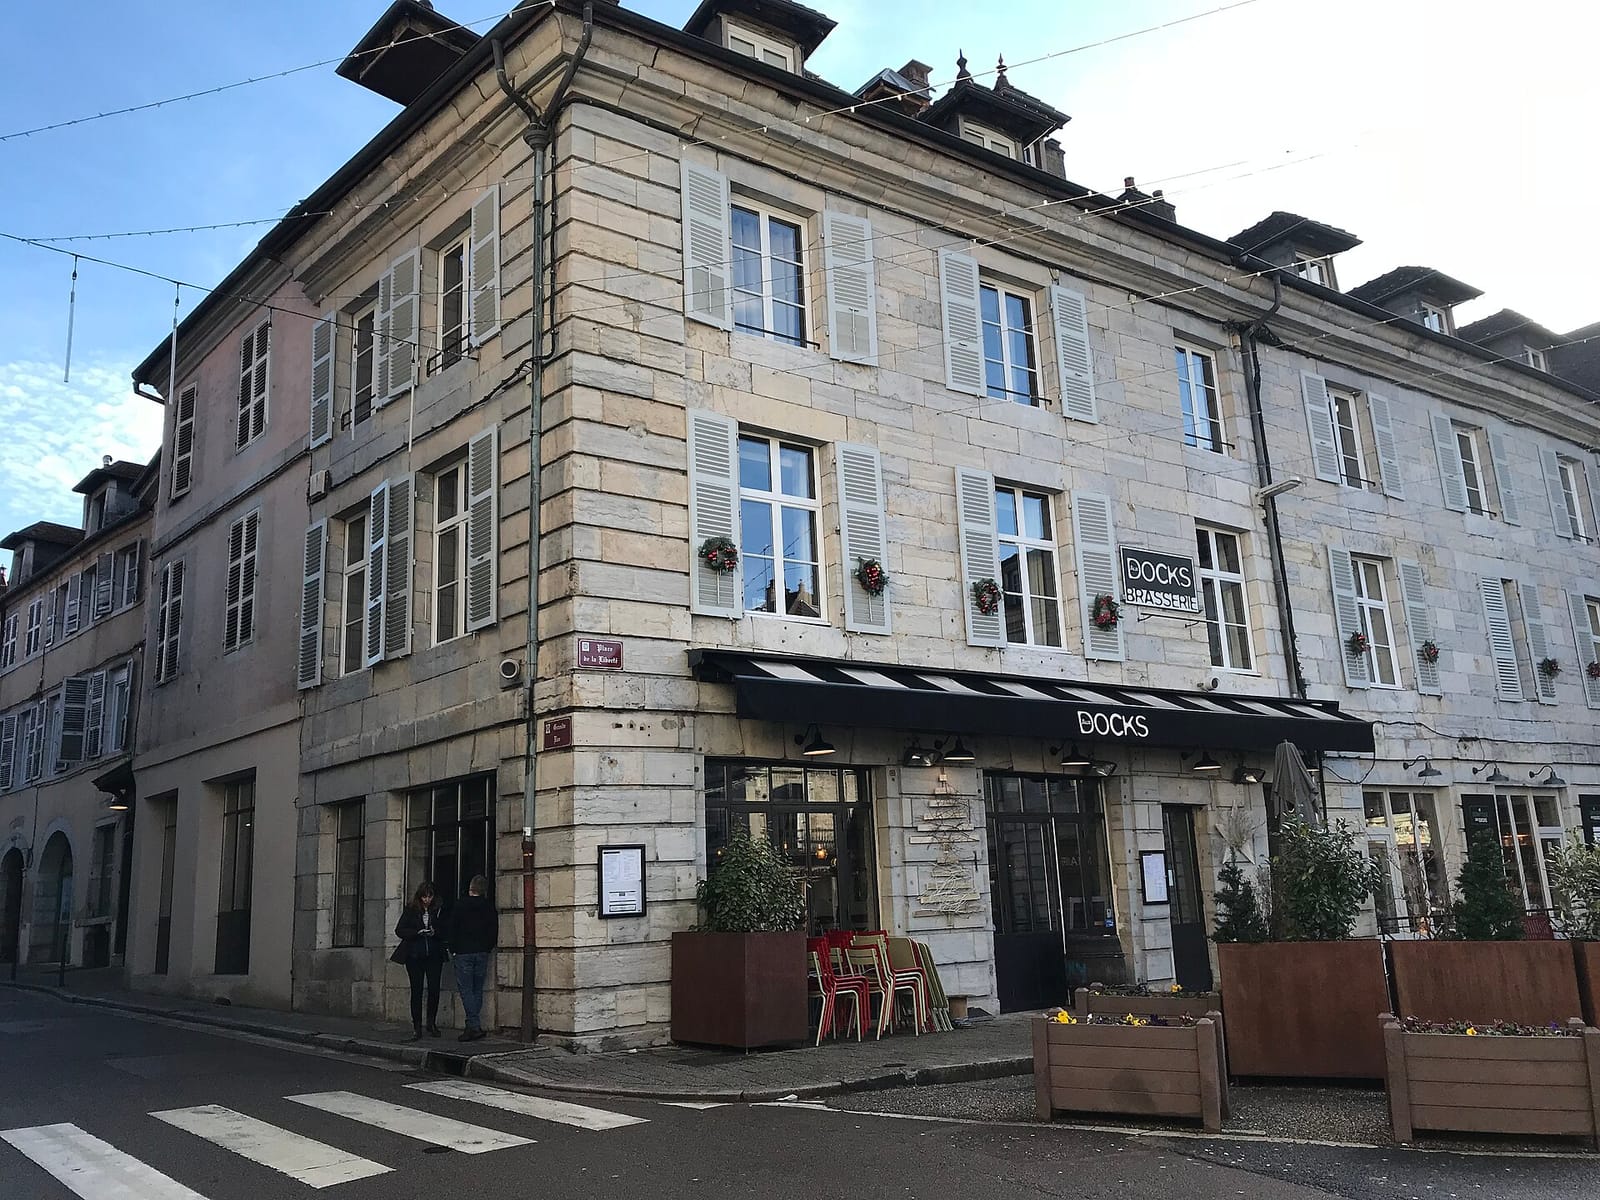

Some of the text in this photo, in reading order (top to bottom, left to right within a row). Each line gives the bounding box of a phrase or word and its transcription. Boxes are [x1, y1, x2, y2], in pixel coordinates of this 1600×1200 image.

[1126, 557, 1191, 588] DOCKS
[1127, 588, 1197, 610] BRASSERIE
[597, 644, 613, 653] Place
[1077, 710, 1149, 738] DOCKS
